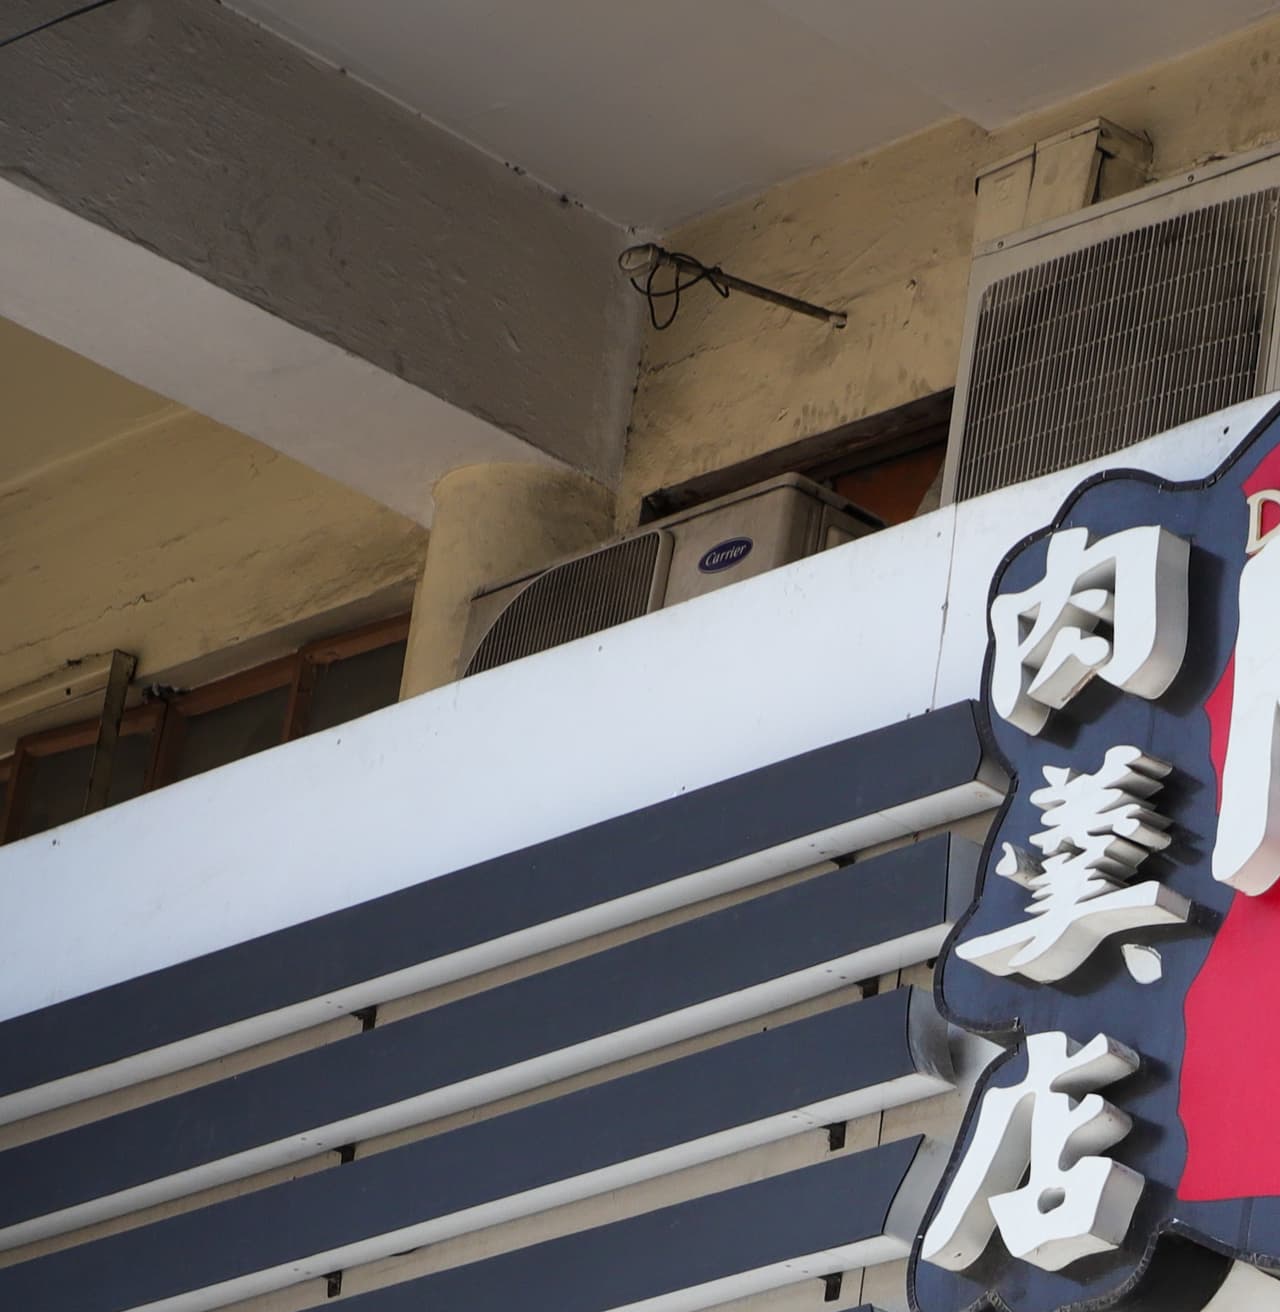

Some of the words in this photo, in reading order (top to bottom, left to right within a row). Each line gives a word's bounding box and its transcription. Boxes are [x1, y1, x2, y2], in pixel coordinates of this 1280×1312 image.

[704, 543, 747, 566] Carrier
[921, 525, 1190, 1271] 肉羹店
